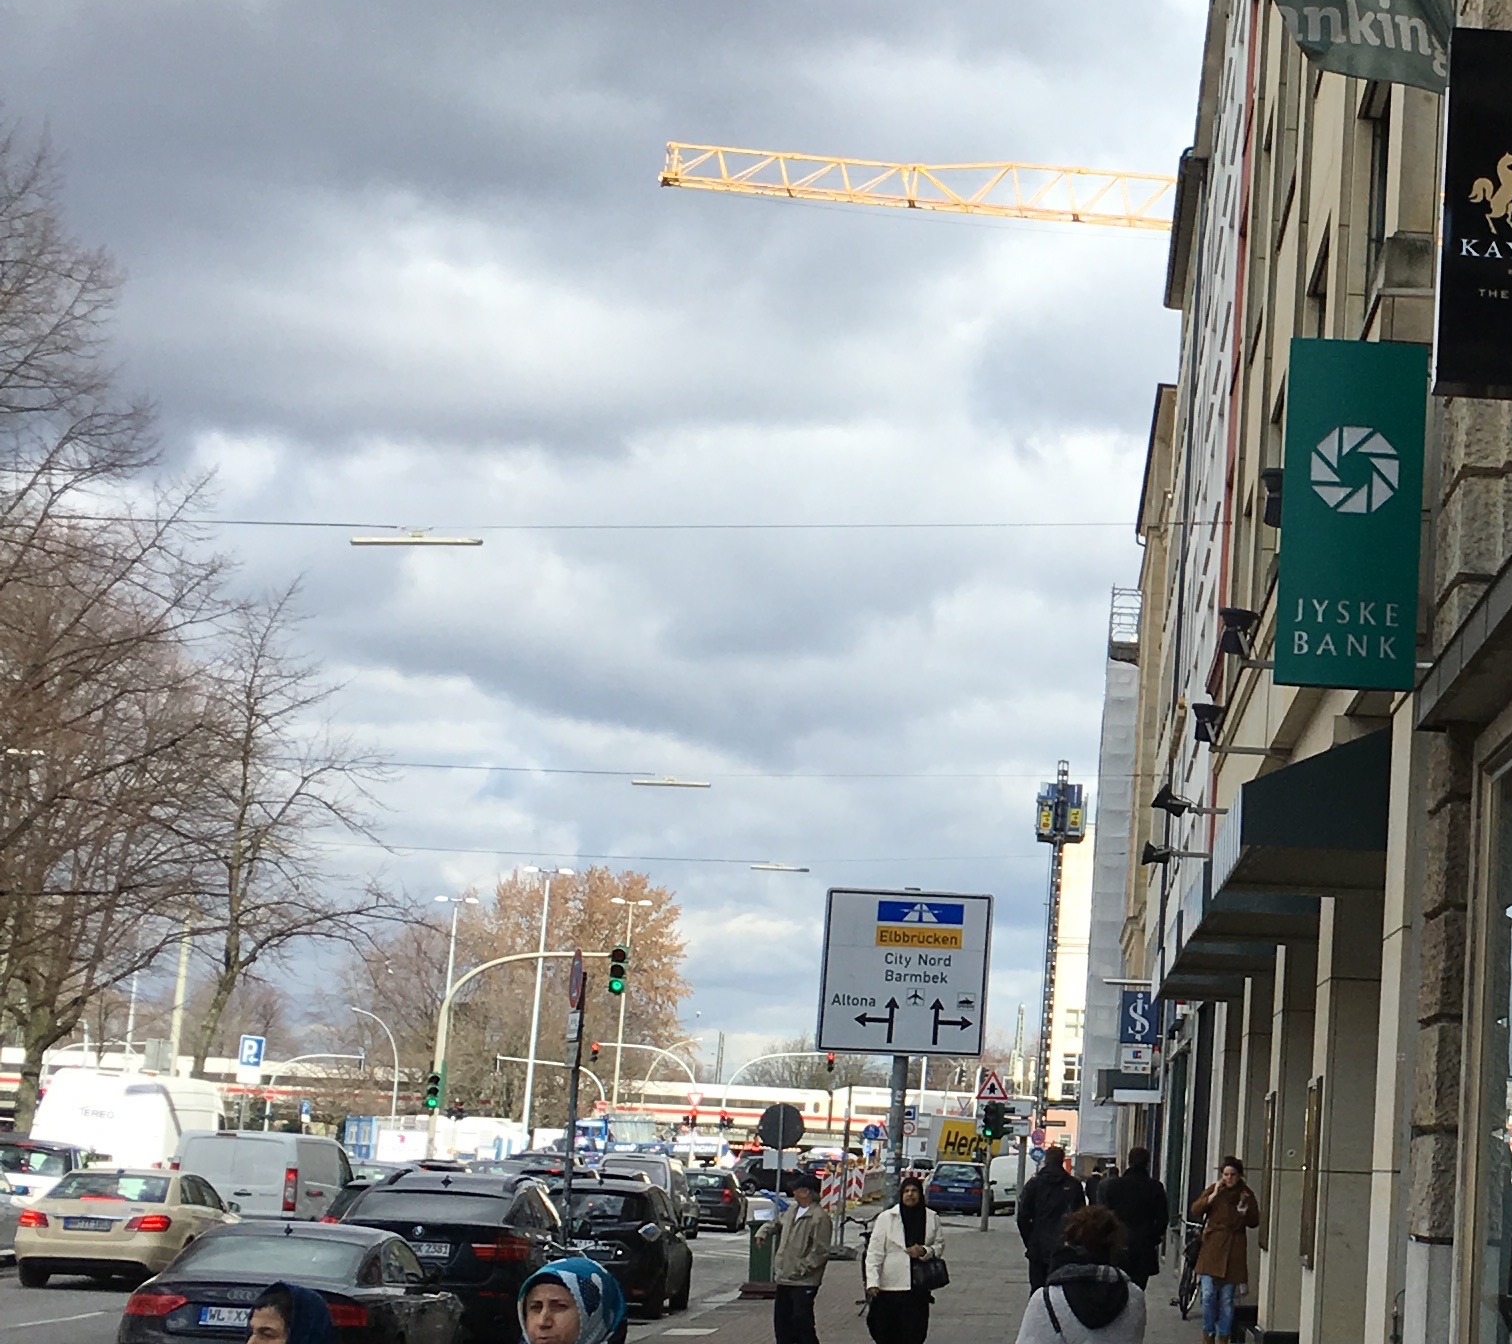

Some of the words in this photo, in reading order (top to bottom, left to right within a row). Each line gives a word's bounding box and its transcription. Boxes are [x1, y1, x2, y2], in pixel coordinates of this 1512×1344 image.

[1478, 288, 1510, 299] THE
[1294, 598, 1400, 627] JYSKE
[1293, 630, 1397, 660] BANK
[879, 929, 958, 946] Elbbrücken
[884, 952, 912, 969] City
[918, 953, 952, 967] Nord
[884, 969, 948, 984] Barmbek
[831, 992, 876, 1007] Altona
